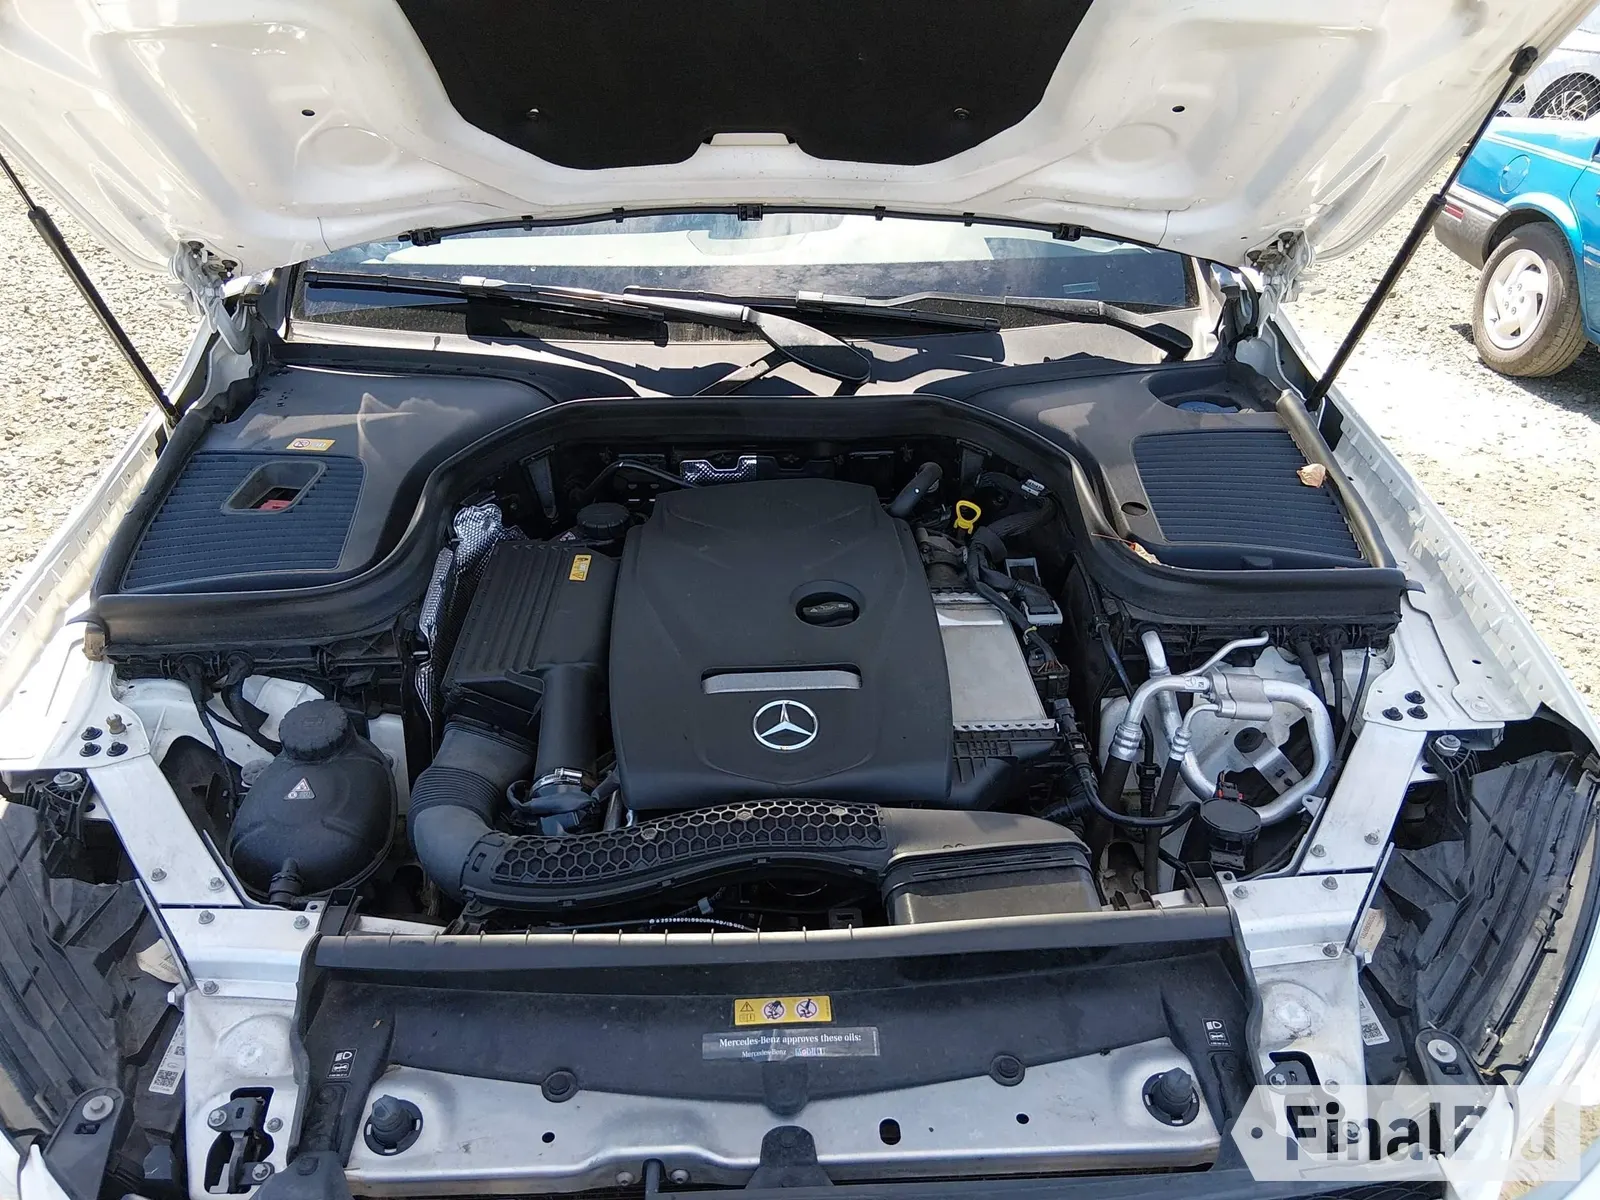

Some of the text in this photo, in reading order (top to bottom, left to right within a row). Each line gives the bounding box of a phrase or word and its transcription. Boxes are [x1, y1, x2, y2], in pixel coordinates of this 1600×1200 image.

[719, 1032, 862, 1048] Mercedes-Benz approves these oils:
[741, 1049, 787, 1059] Mercedes-Benz
